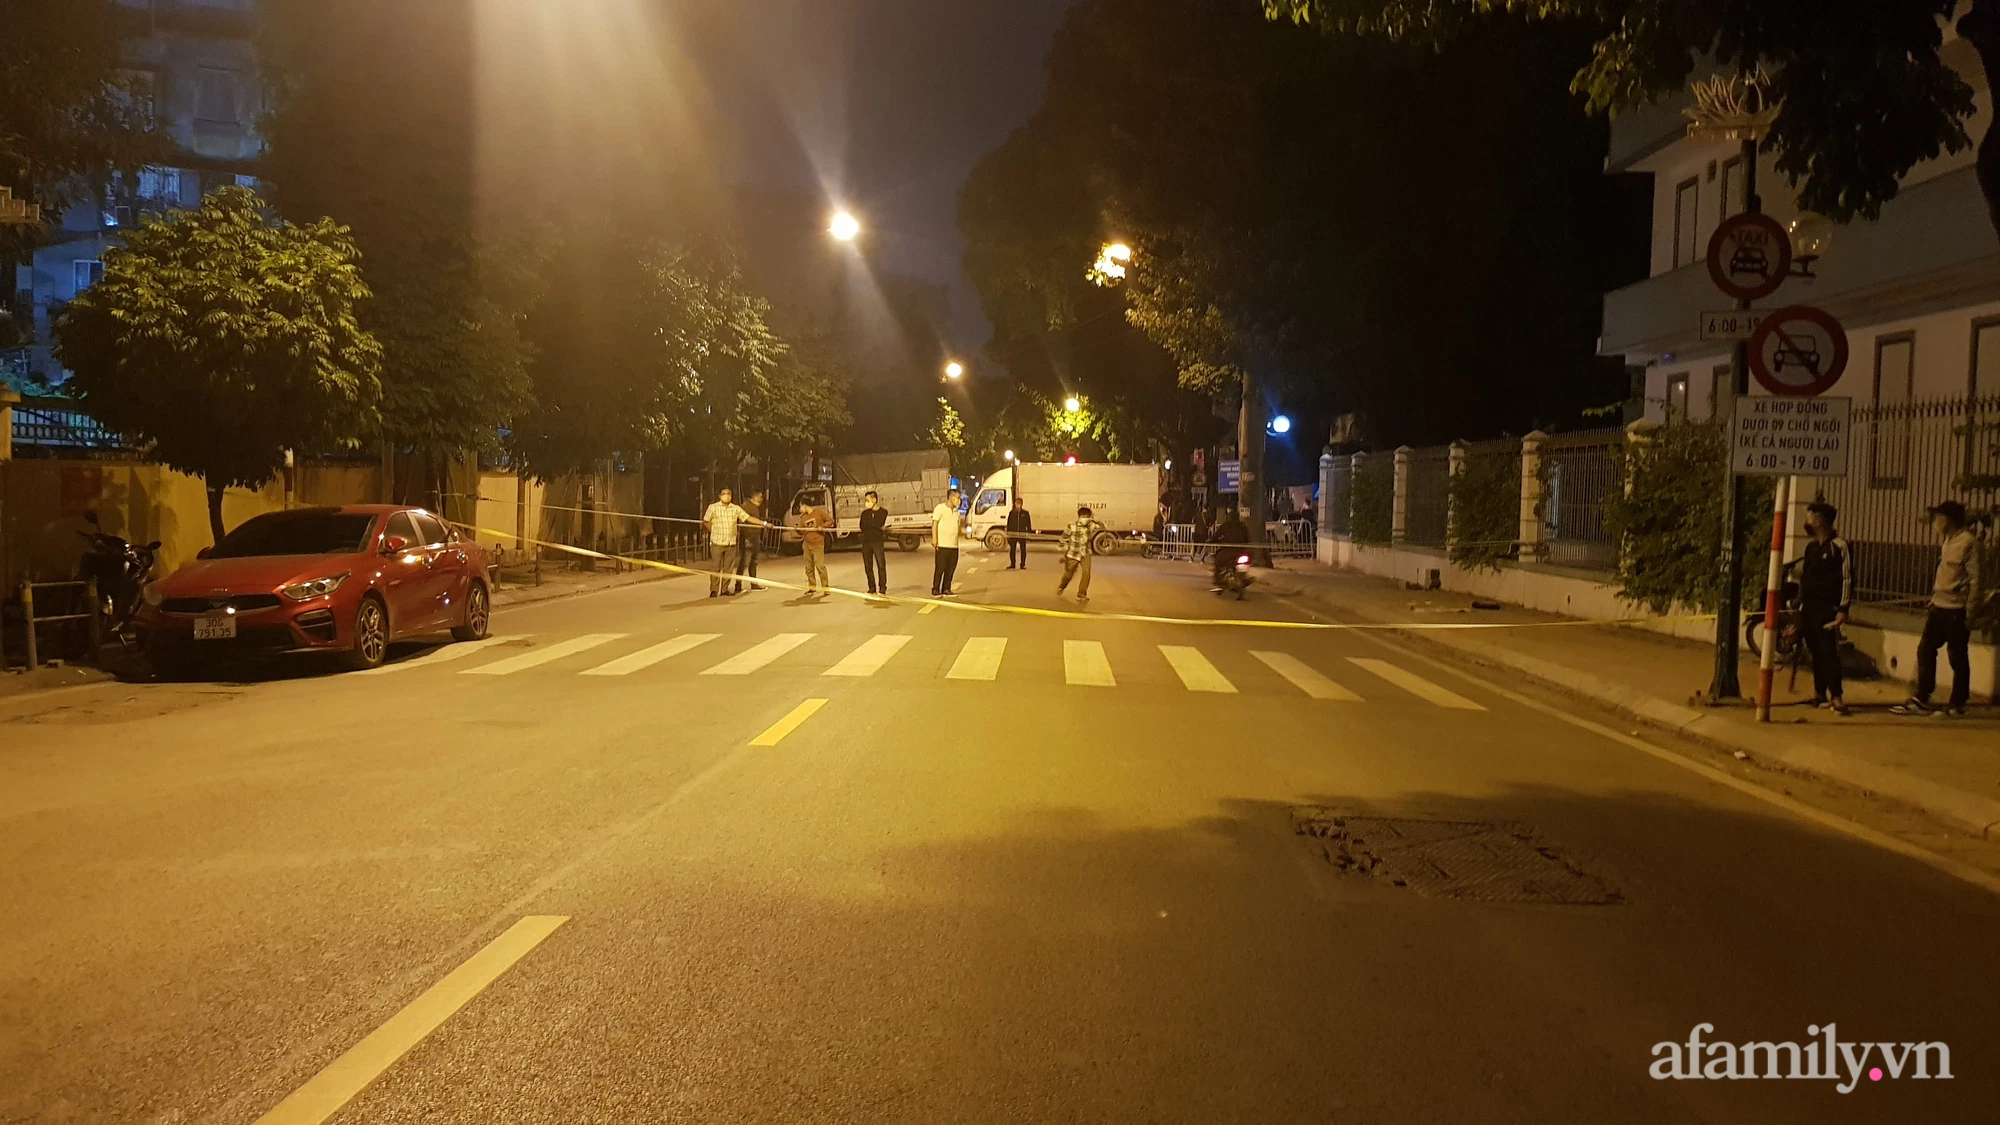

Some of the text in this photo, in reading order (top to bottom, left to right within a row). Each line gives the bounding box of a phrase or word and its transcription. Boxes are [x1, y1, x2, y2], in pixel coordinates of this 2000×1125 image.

[1738, 230, 1769, 245] TAXI
[1754, 401, 1766, 413] XE
[1772, 419, 1784, 430] 09
